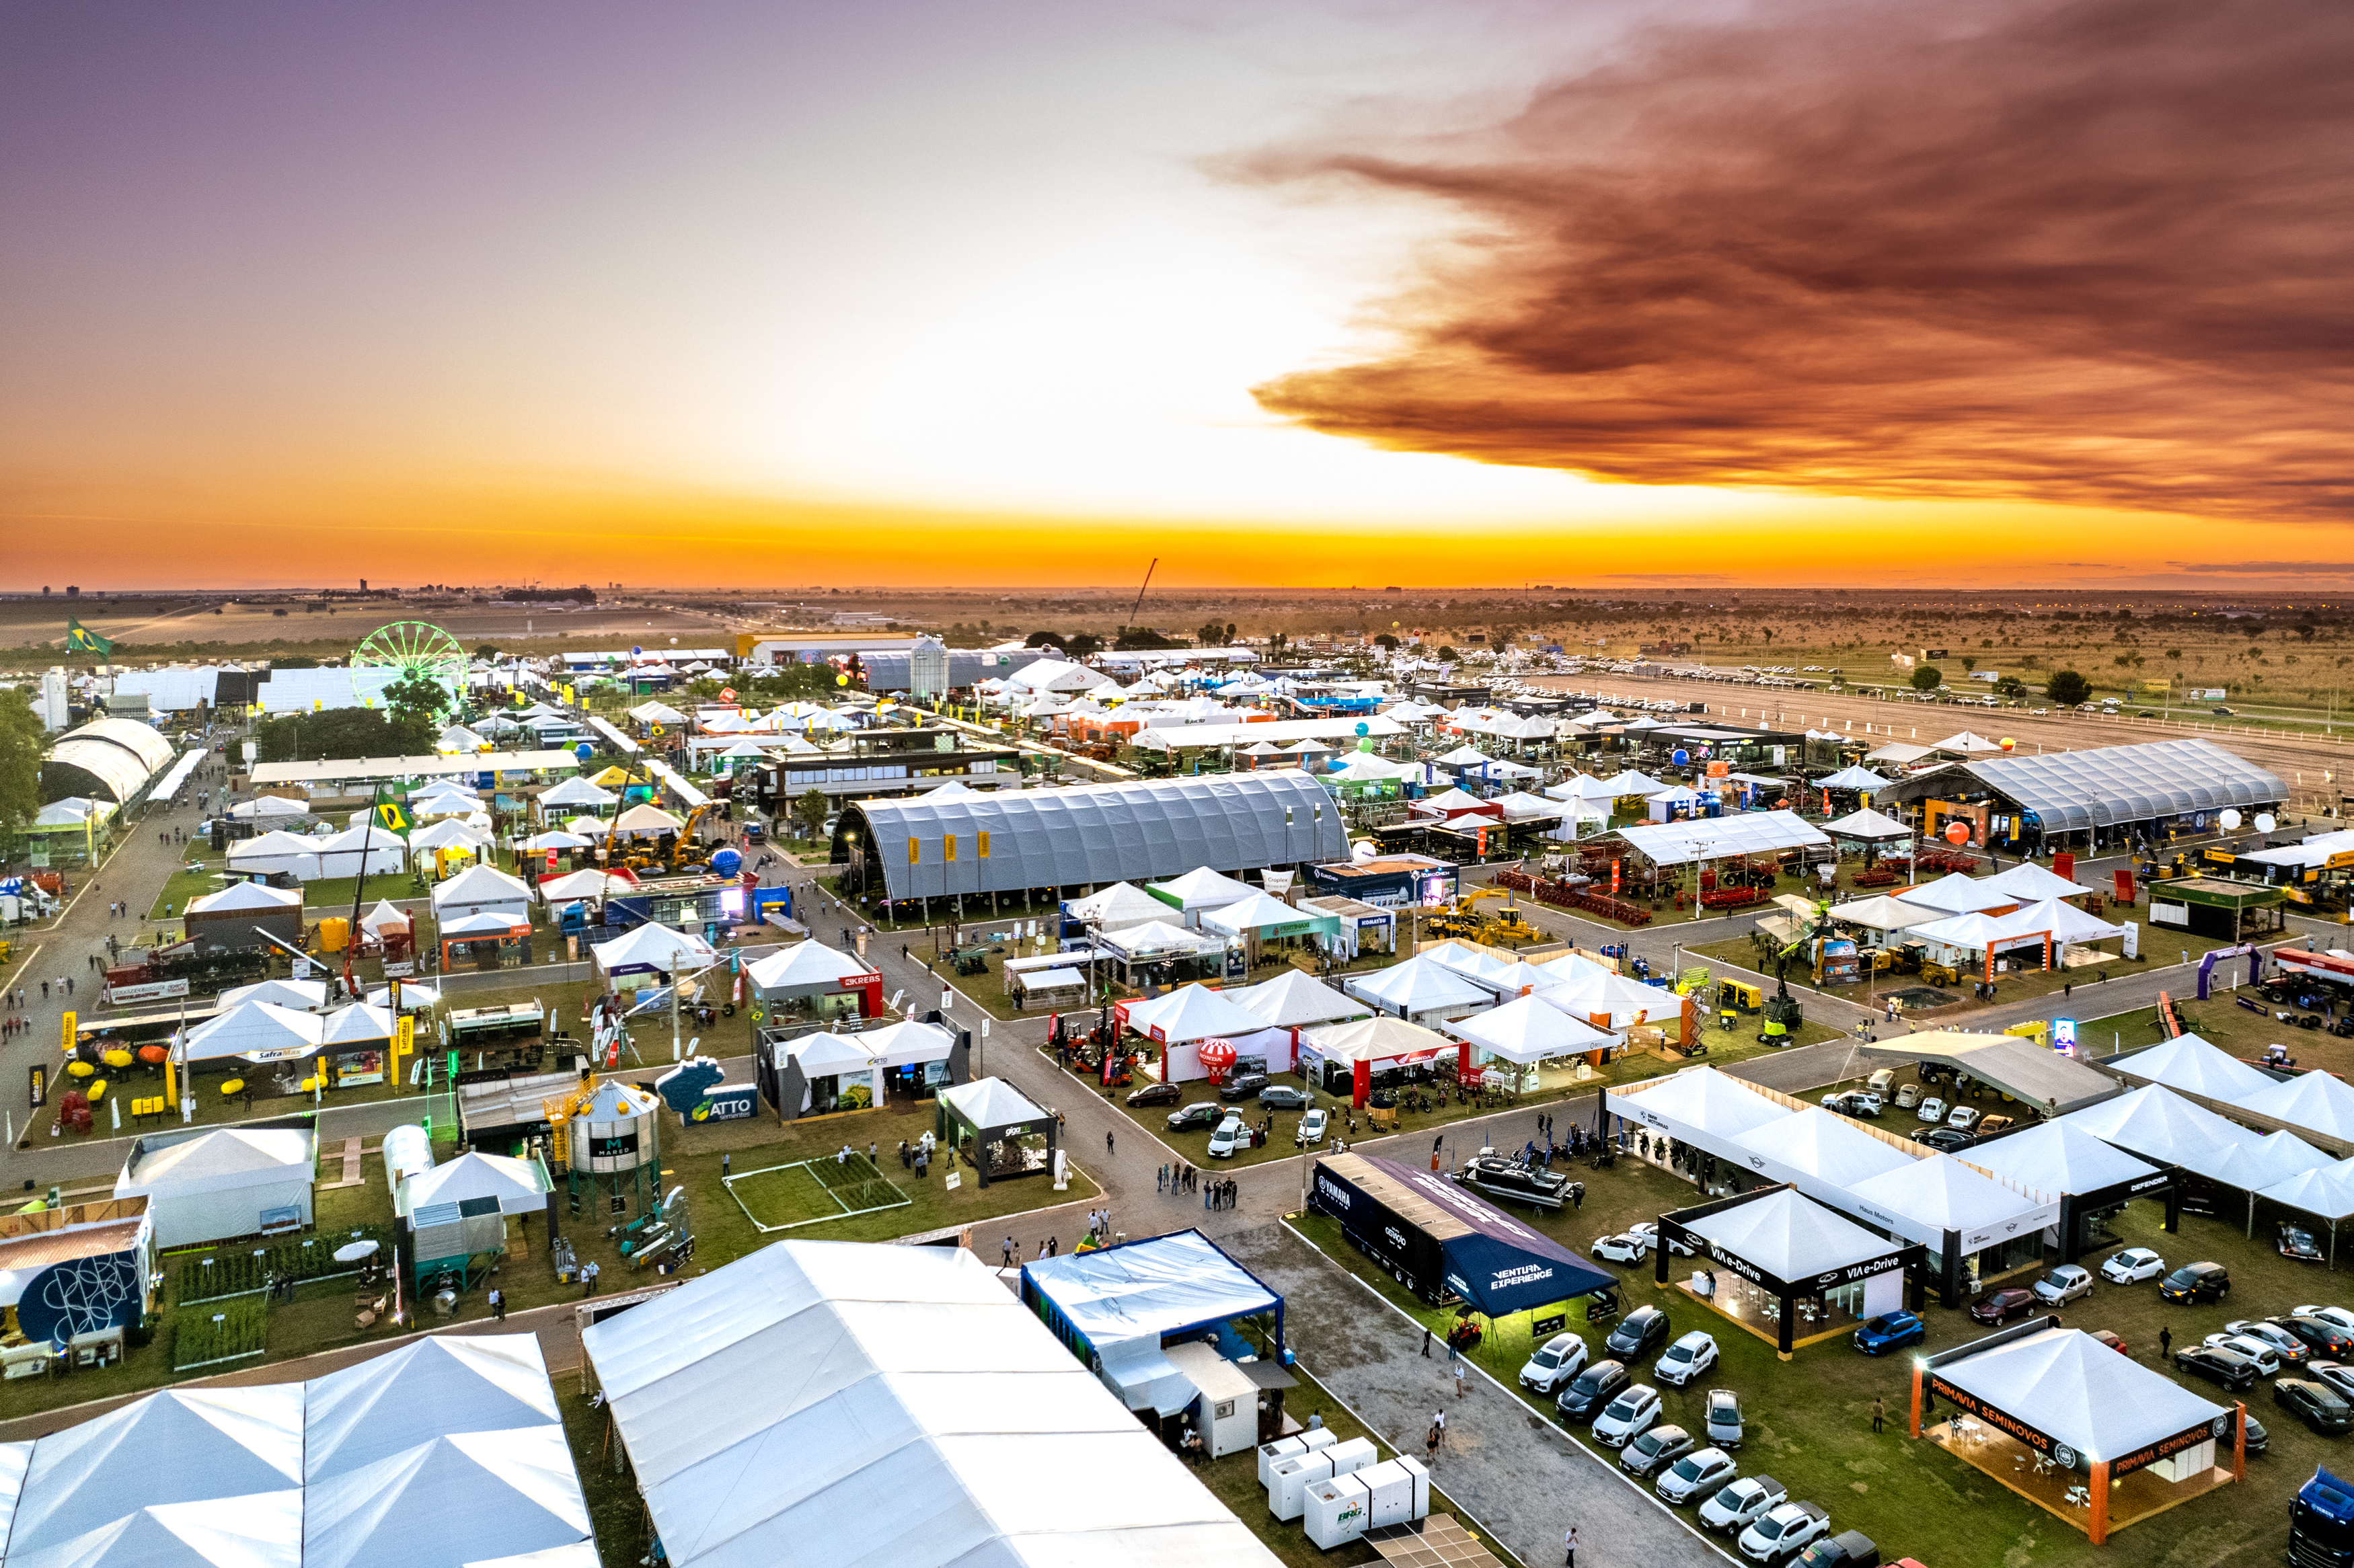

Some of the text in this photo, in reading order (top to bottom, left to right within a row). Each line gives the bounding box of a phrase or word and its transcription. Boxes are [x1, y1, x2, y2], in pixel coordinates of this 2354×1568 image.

[1361, 917, 1386, 926] KOMATSU
[851, 975, 880, 984] KREBS
[1616, 1012, 1647, 1024] teogera
[259, 1048, 301, 1059] SafraMax
[1309, 1042, 1323, 1052] HONDA
[1199, 1052, 1223, 1062] HONDA
[710, 1099, 751, 1116] ATTO
[719, 1111, 751, 1121] sementes
[1005, 1124, 1031, 1136] gigamix
[1647, 1118, 1669, 1130] MOTORRAD
[599, 1147, 629, 1156] MARED
[2131, 1176, 2168, 1191] DEFENDER
[1321, 1189, 1349, 1210] RACING
[1325, 1179, 1351, 1208] YAMAHA
[1859, 1204, 1894, 1224] Haus Motors
[1385, 1226, 1406, 1246] GERAÇÃO
[1710, 1245, 1761, 1282] VIA e-Drive
[1847, 1257, 1899, 1279] VIA e-Drive
[1451, 1272, 1467, 1287] VENTURA
[1490, 1268, 1553, 1290] EXPERIENCE
[1491, 1264, 1542, 1280] VENTURA
[1447, 1276, 1470, 1294] EXPERIENCE
[1932, 1378, 2048, 1450] PRIMAVIA SEMINOVOS
[2116, 1426, 2209, 1473] PRIMAVIA SEMINOVOS
[1338, 1507, 1363, 1522] BRG
